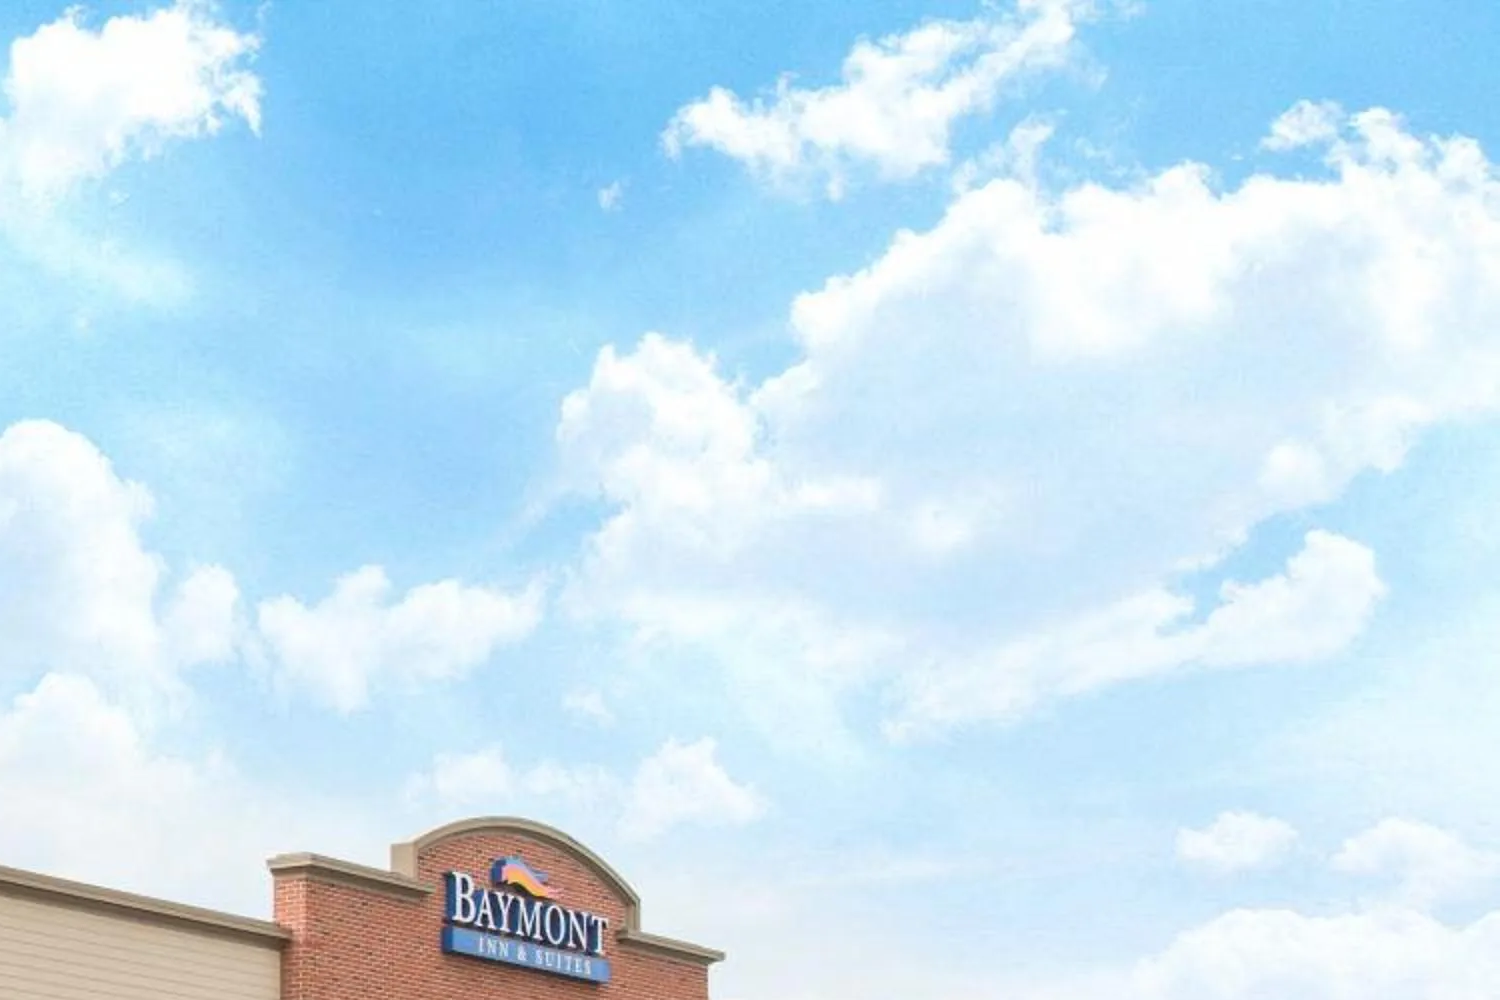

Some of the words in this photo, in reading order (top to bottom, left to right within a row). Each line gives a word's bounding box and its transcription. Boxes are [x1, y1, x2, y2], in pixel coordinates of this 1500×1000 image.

[451, 871, 609, 954] BAYMONT
[479, 936, 509, 957] INN
[517, 945, 527, 961] &
[535, 949, 592, 975] SUITES
